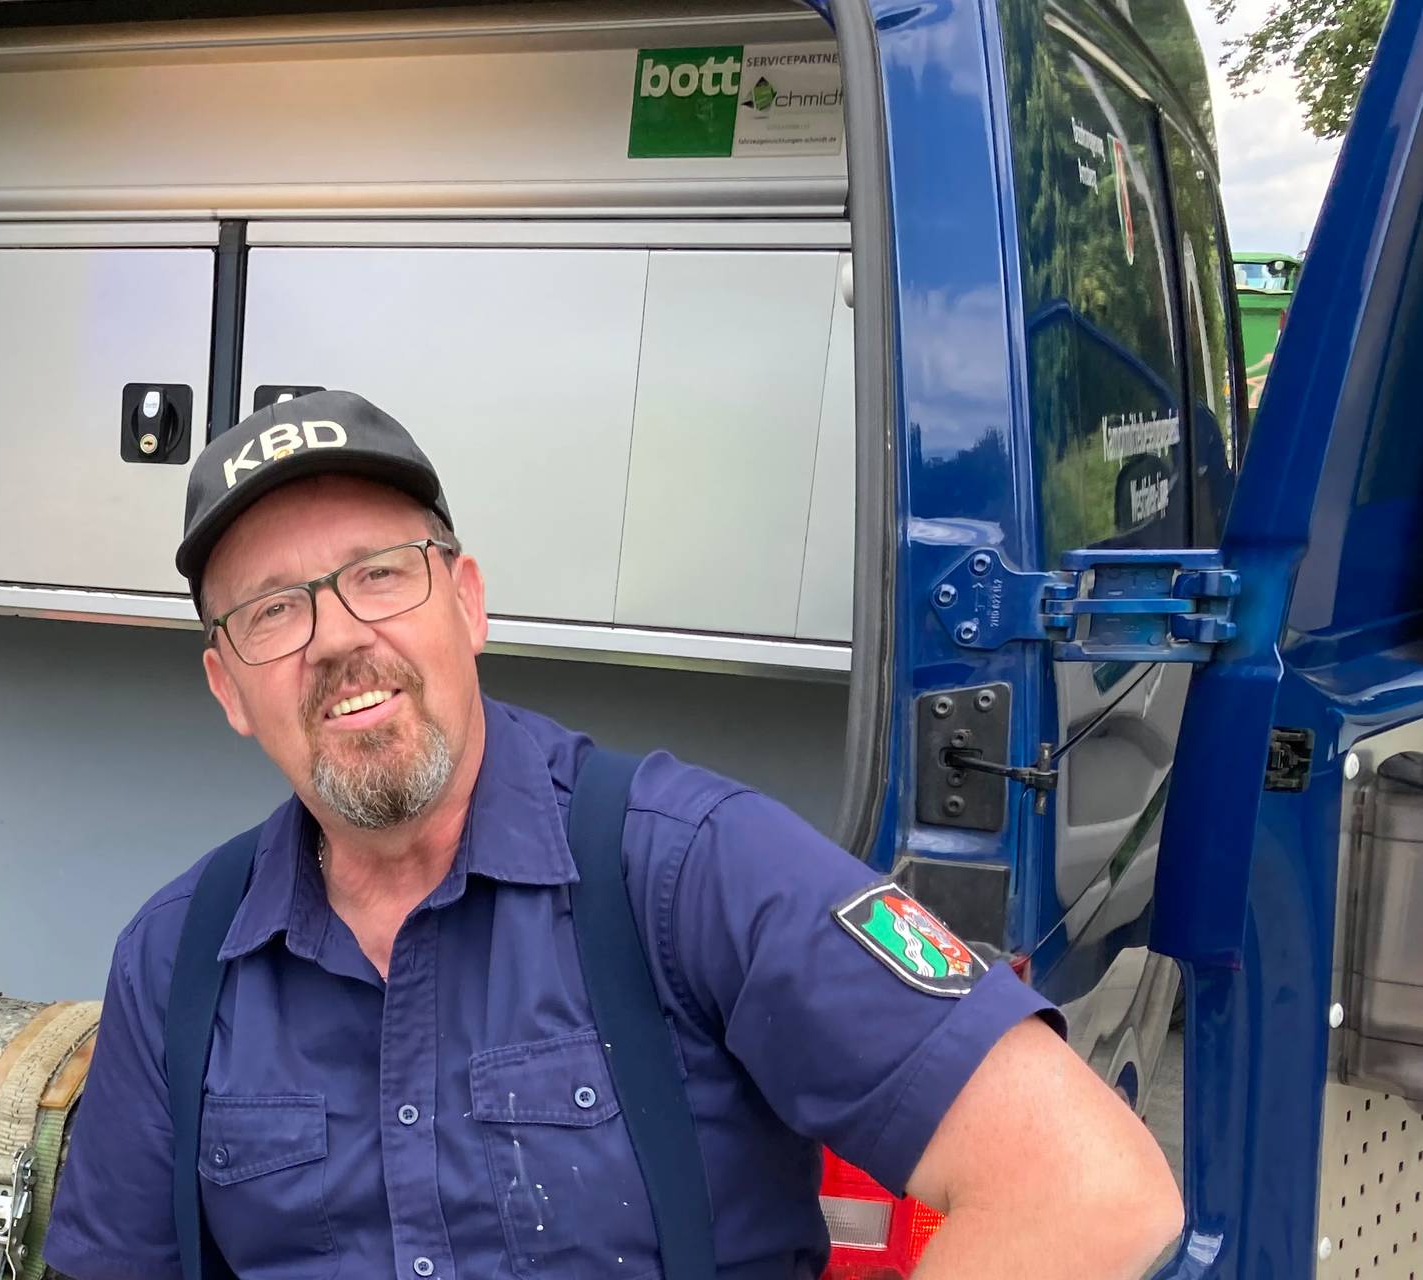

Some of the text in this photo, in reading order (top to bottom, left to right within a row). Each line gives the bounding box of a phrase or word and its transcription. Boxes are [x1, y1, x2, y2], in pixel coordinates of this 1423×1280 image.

[640, 56, 742, 97] bott
[746, 54, 840, 67] SERVICEPARTNE
[222, 420, 348, 489] KBD
